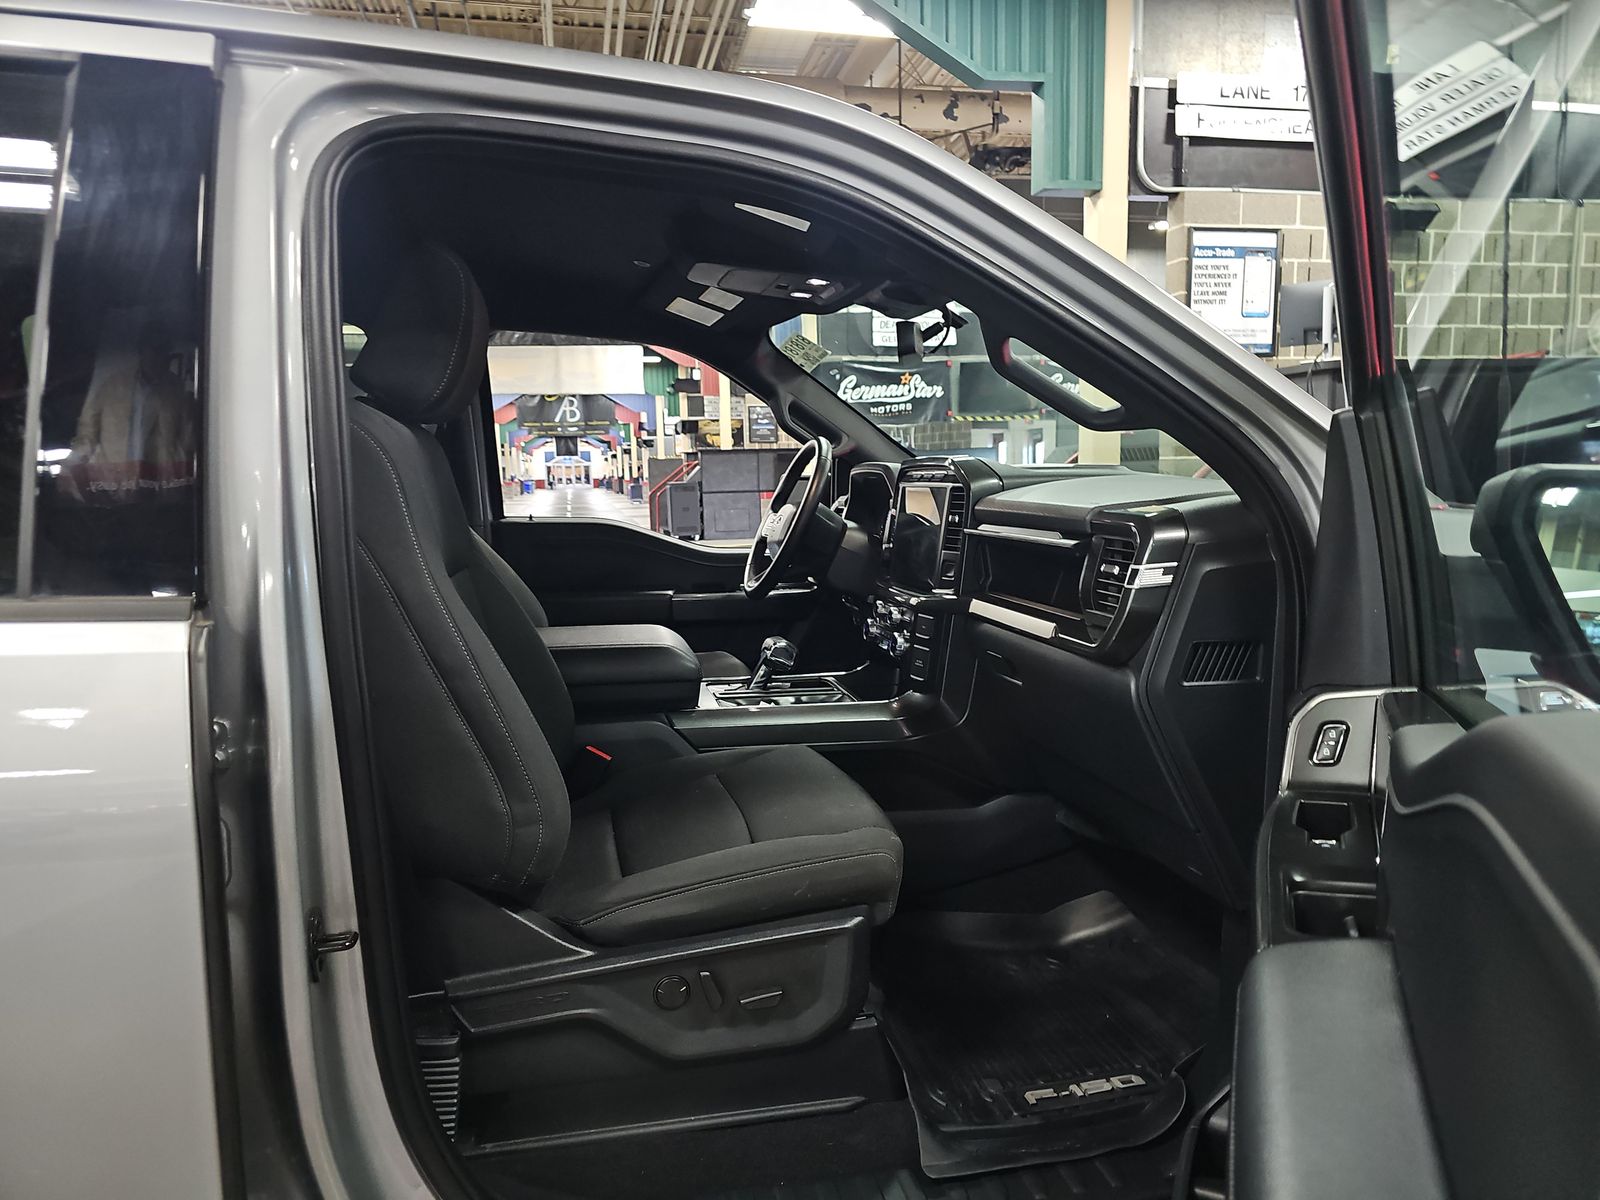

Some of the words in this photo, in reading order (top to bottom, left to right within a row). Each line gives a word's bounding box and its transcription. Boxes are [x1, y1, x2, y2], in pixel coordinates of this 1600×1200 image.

[1220, 86, 1271, 100] LANE
[1194, 247, 1235, 257] Accu-Trade
[870, 403, 912, 414] MOTORS
[1024, 1074, 1146, 1105] F-150
